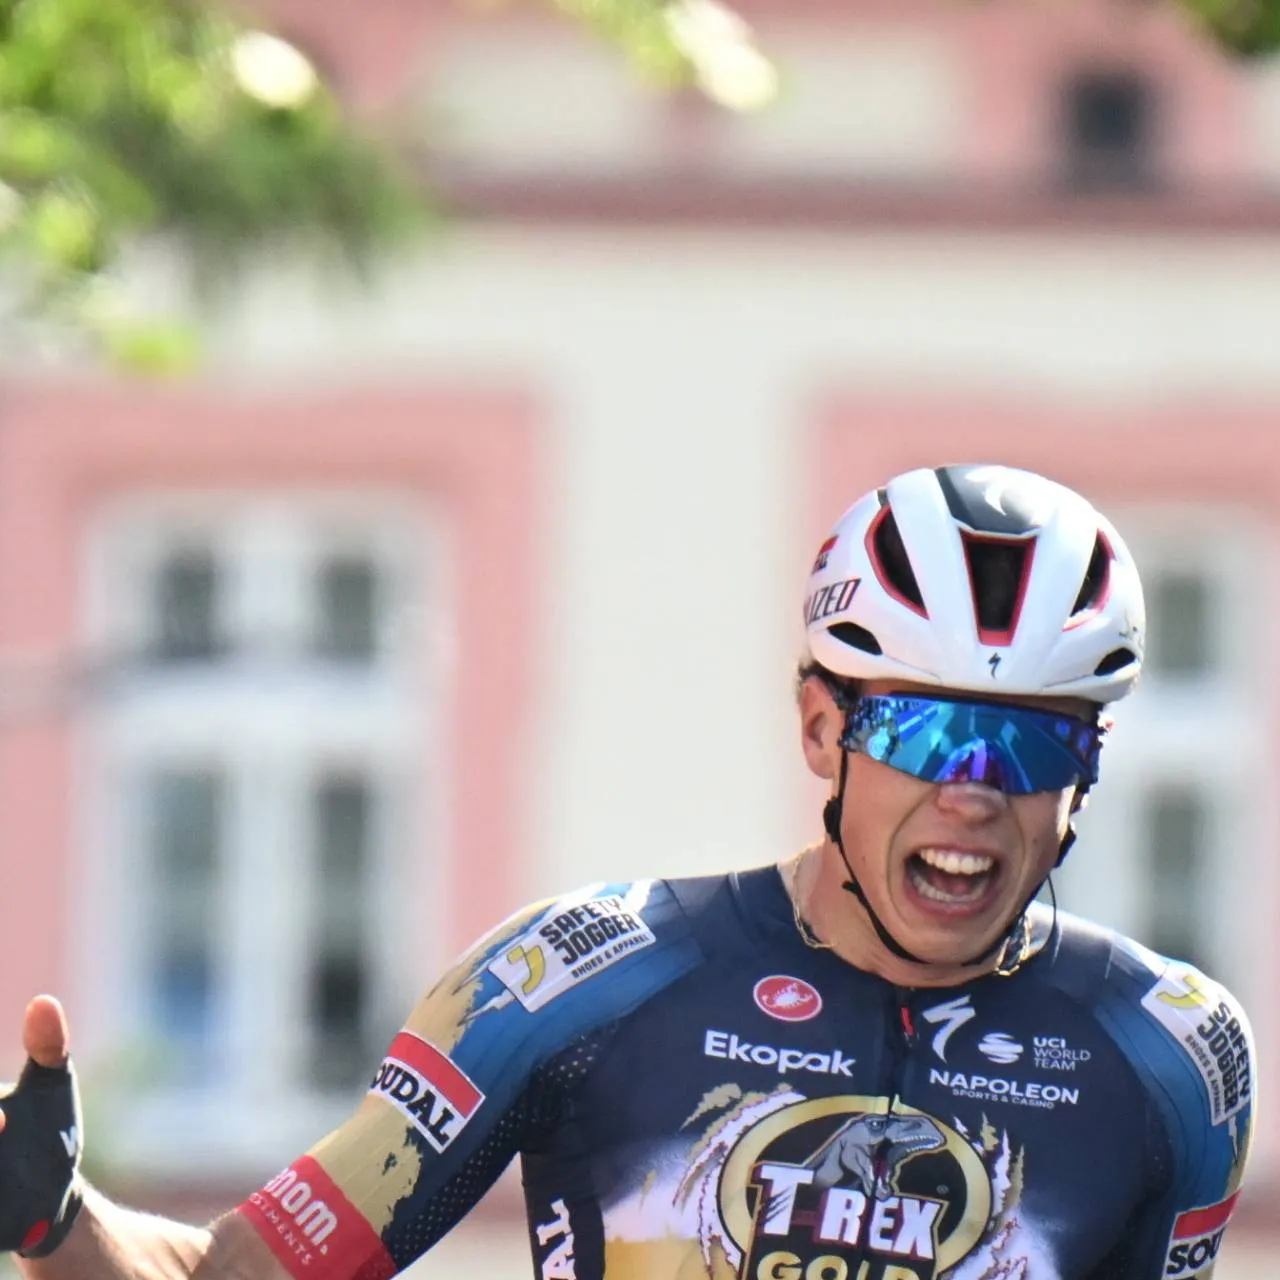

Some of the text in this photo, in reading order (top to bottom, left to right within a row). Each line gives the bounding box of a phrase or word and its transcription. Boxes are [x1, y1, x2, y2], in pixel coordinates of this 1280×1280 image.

[803, 578, 861, 627] IZED
[539, 898, 621, 944] SAFETY
[553, 914, 640, 965] JOGGER
[704, 1030, 856, 1077] Ekopak
[1033, 1037, 1066, 1048] UCI
[1033, 1047, 1091, 1061] WORLD
[1033, 1057, 1076, 1071] TEAM
[1197, 1015, 1239, 1113] JOGGER
[1213, 1001, 1250, 1099] SAFETY
[371, 1063, 455, 1147] OUDAL
[929, 1068, 1079, 1104] NAPOLEON
[953, 1089, 1055, 1109] SPORTS & CASINO
